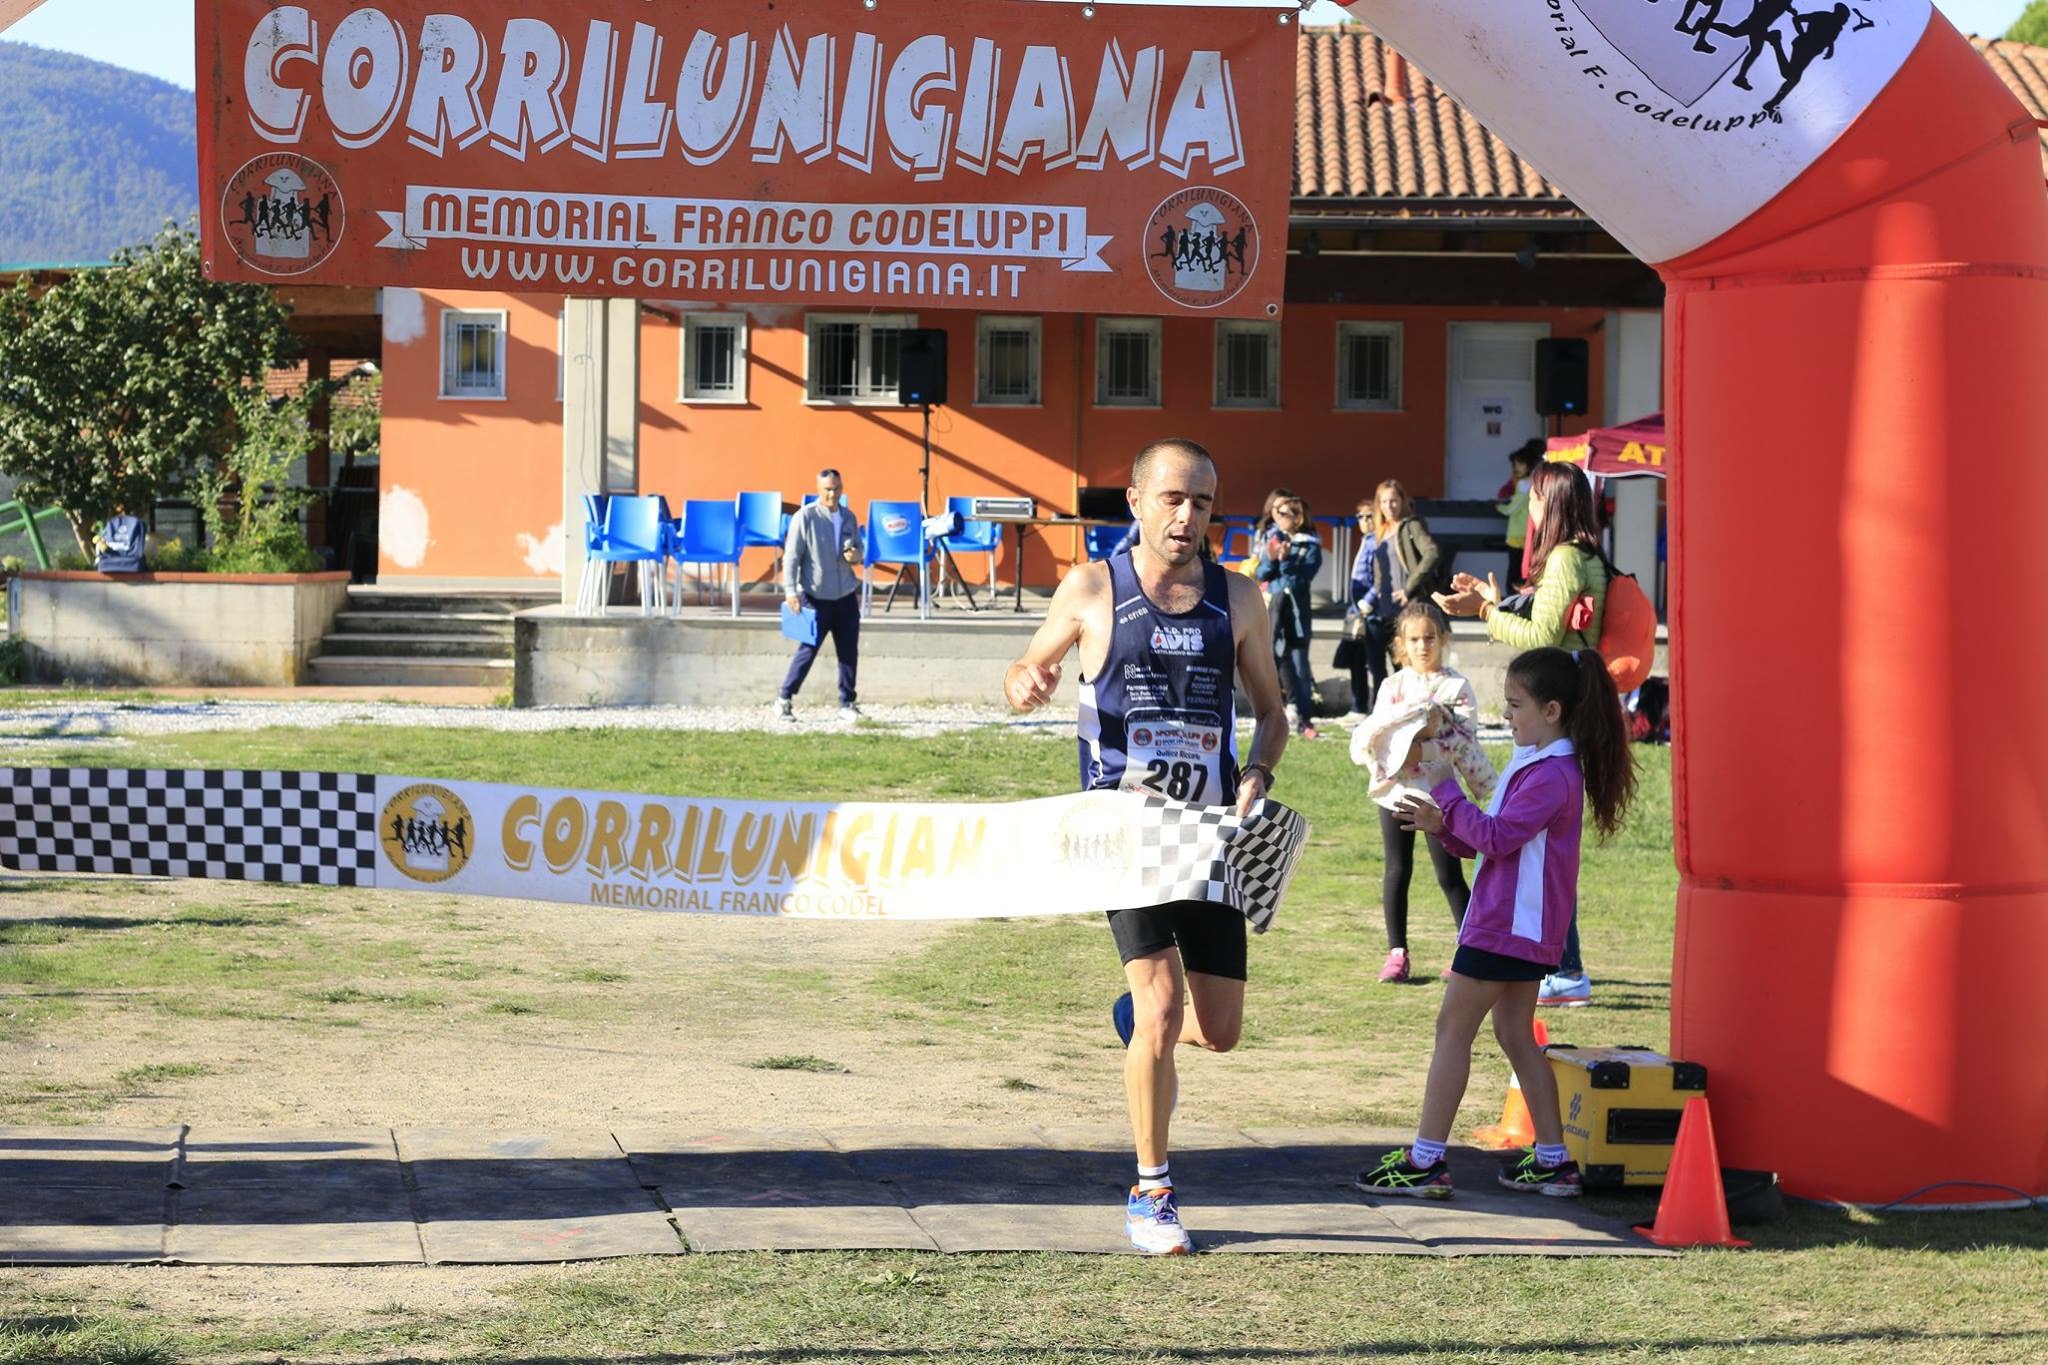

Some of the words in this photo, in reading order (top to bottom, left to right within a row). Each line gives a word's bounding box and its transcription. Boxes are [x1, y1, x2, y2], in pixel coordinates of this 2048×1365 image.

[244, 5, 1246, 181] CORRILUNIGIANA
[1583, 65, 1608, 89] F.
[1615, 90, 1783, 132] Codeluppi
[422, 192, 657, 243] MEMORIAL
[675, 204, 832, 246] FRANCO
[848, 208, 1068, 252] CODELUPPI
[462, 247, 1027, 298] WWW.CORRILUNIGIANA.IT
[1150, 632, 1205, 651] AVIS
[1183, 627, 1201, 635] PRO
[1141, 758, 1208, 802] 287
[590, 883, 713, 911] MEMORIAL
[719, 890, 811, 915] FRANCO
